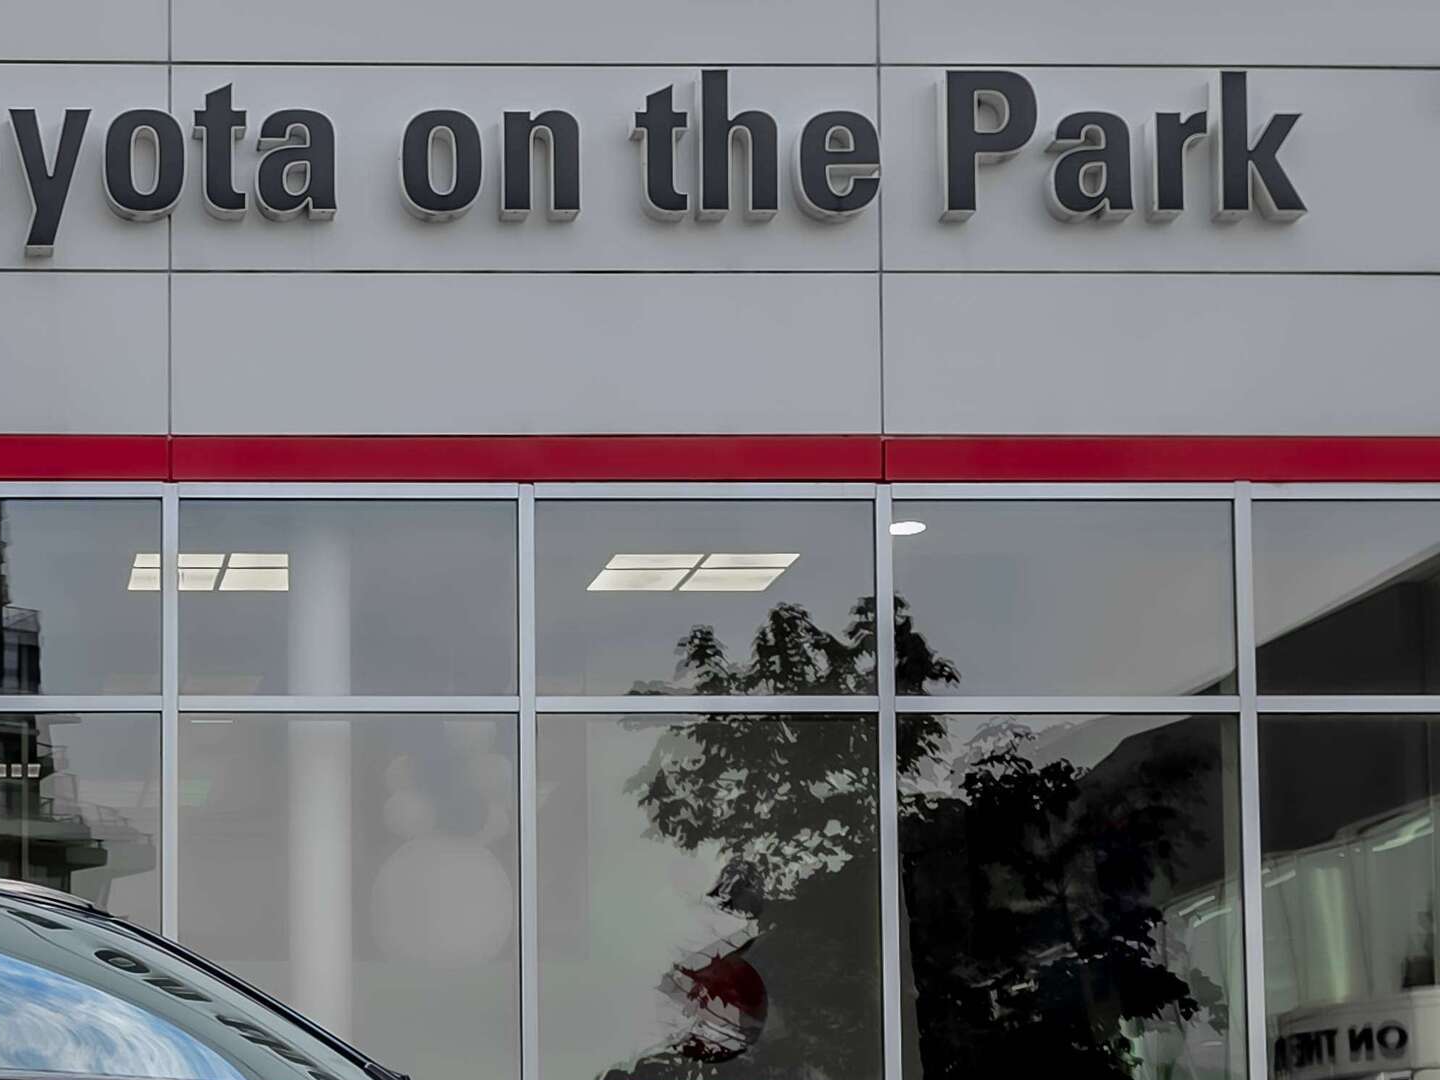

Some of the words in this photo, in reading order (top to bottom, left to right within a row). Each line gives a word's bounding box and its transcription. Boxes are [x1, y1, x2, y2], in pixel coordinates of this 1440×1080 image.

[399, 108, 582, 223] on
[628, 69, 881, 225] the
[936, 70, 1308, 224] Park
